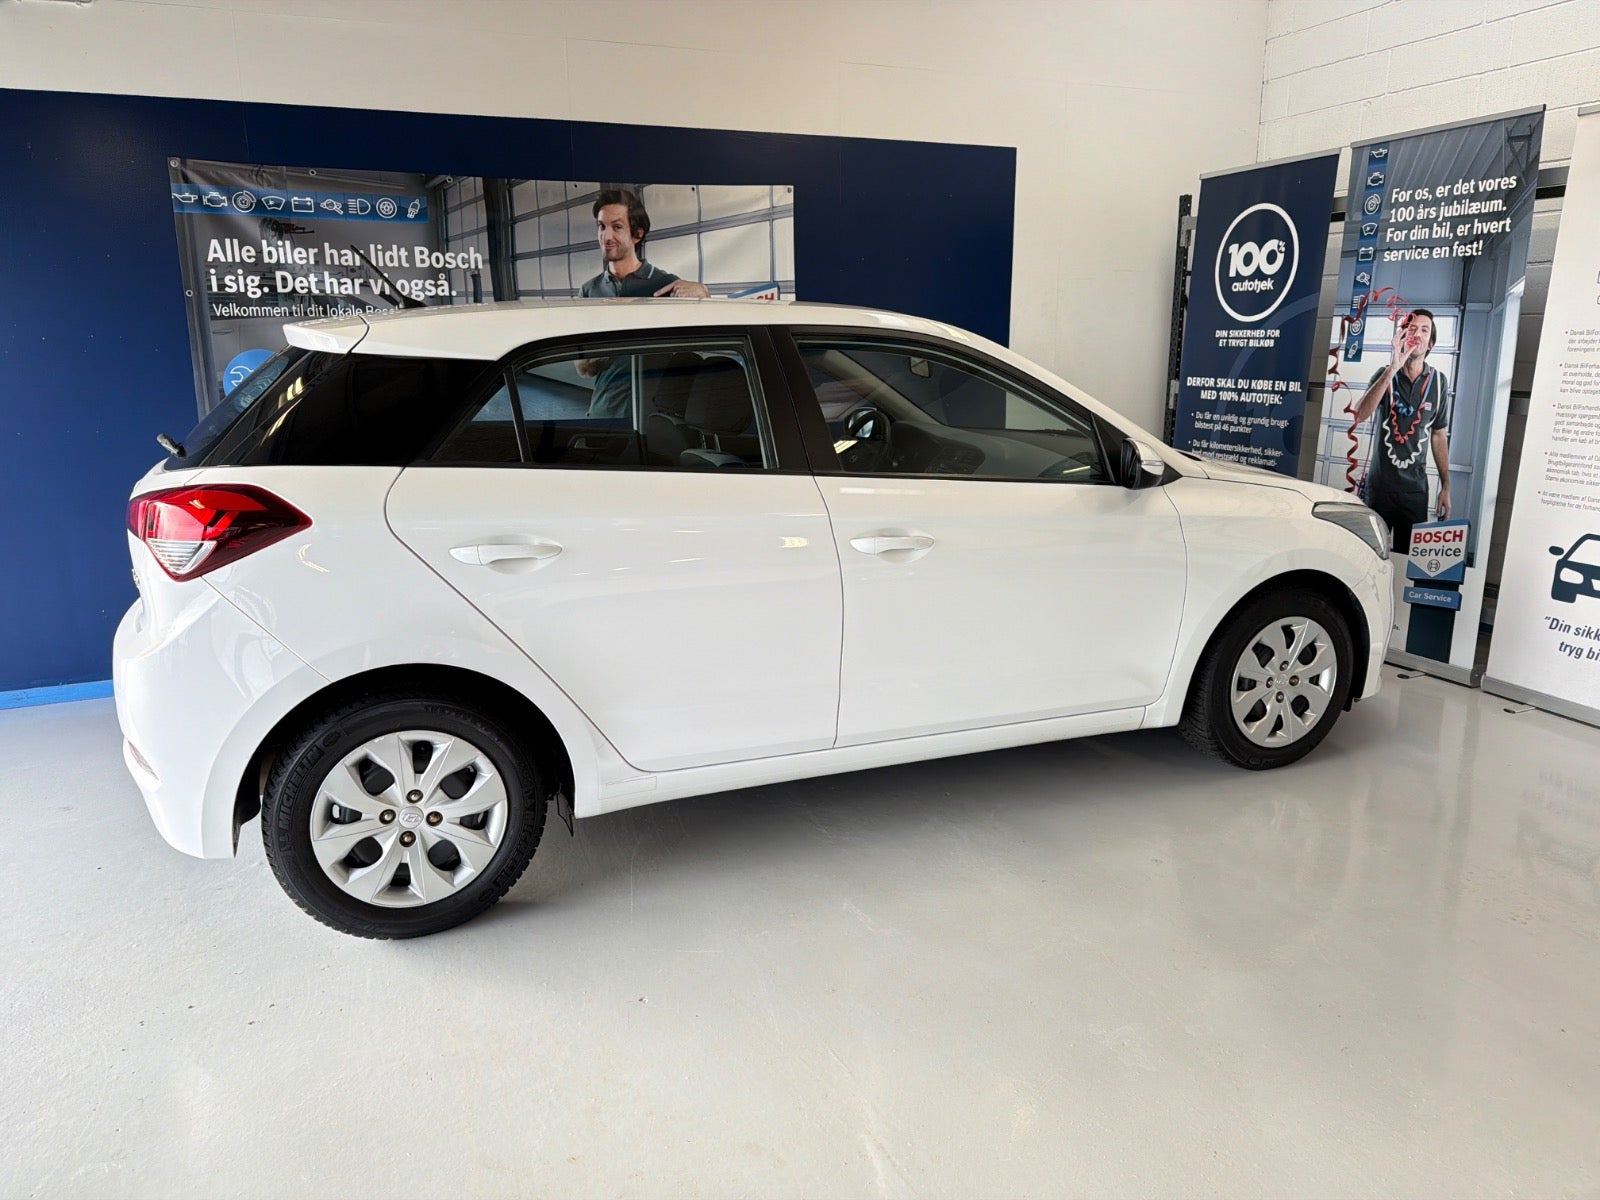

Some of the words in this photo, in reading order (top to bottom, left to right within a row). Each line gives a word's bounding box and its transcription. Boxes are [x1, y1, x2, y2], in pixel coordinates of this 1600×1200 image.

[1391, 188, 1412, 203] For
[1415, 188, 1433, 201] os,
[1435, 184, 1451, 197] er
[1453, 179, 1475, 196] det
[1478, 175, 1518, 192] vores
[1389, 206, 1415, 223] 100
[1417, 203, 1436, 219] års
[1438, 199, 1507, 221] jubilæum.
[1386, 227, 1407, 243] For
[1410, 223, 1429, 241] din
[1432, 222, 1453, 240] bil,
[1456, 224, 1471, 237] er
[1473, 217, 1511, 235] hvert
[207, 239, 256, 264] Alle
[263, 241, 318, 266] biler
[324, 243, 364, 267] har
[369, 244, 410, 268] lidt
[414, 246, 483, 270] Bosch
[1383, 246, 1429, 262] service
[1432, 246, 1450, 259] en
[1452, 240, 1483, 257] fest!
[210, 269, 217, 293] i
[224, 271, 269, 298] sig.
[275, 271, 318, 295] Det
[324, 273, 361, 295] har
[369, 273, 390, 296] vi
[396, 274, 457, 301] også.
[1231, 278, 1274, 293] autotjek
[212, 303, 288, 318] Velkommen
[291, 304, 305, 318] til
[307, 304, 325, 318] dit
[327, 304, 363, 318] lokale
[1215, 329, 1228, 338] DIN
[1229, 329, 1265, 338] SIKKERHED
[1267, 329, 1280, 338] FOR
[1219, 339, 1227, 347] ET
[1228, 339, 1248, 347] TRYGT
[1249, 339, 1275, 347] BILKØB
[1186, 376, 1215, 387] DERFOR
[1216, 378, 1236, 389] SKAL
[1237, 379, 1250, 389] DU
[1251, 379, 1273, 390] KØBE
[1274, 380, 1287, 391] EN
[1288, 381, 1302, 392] BIL
[1200, 390, 1217, 400] MED
[1219, 390, 1238, 401] 100%
[1240, 392, 1283, 406] AUTOTJEK:
[1195, 411, 1204, 419] Du
[1204, 411, 1212, 420] får
[1239, 416, 1247, 425] og
[1247, 416, 1269, 427] grundig
[1270, 418, 1290, 429] brugt-
[1214, 422, 1221, 432] på
[1222, 423, 1230, 431] 46
[1230, 425, 1252, 434] punkter
[1192, 439, 1200, 447] Du
[1201, 439, 1209, 448] får
[1240, 456, 1247, 465] og
[1413, 529, 1464, 544] BOSCH
[1411, 545, 1461, 557] Service
[1408, 591, 1422, 600] Car
[1424, 592, 1452, 603] Service
[1558, 641, 1583, 660] tryg
[279, 744, 324, 830] MICHELIN
